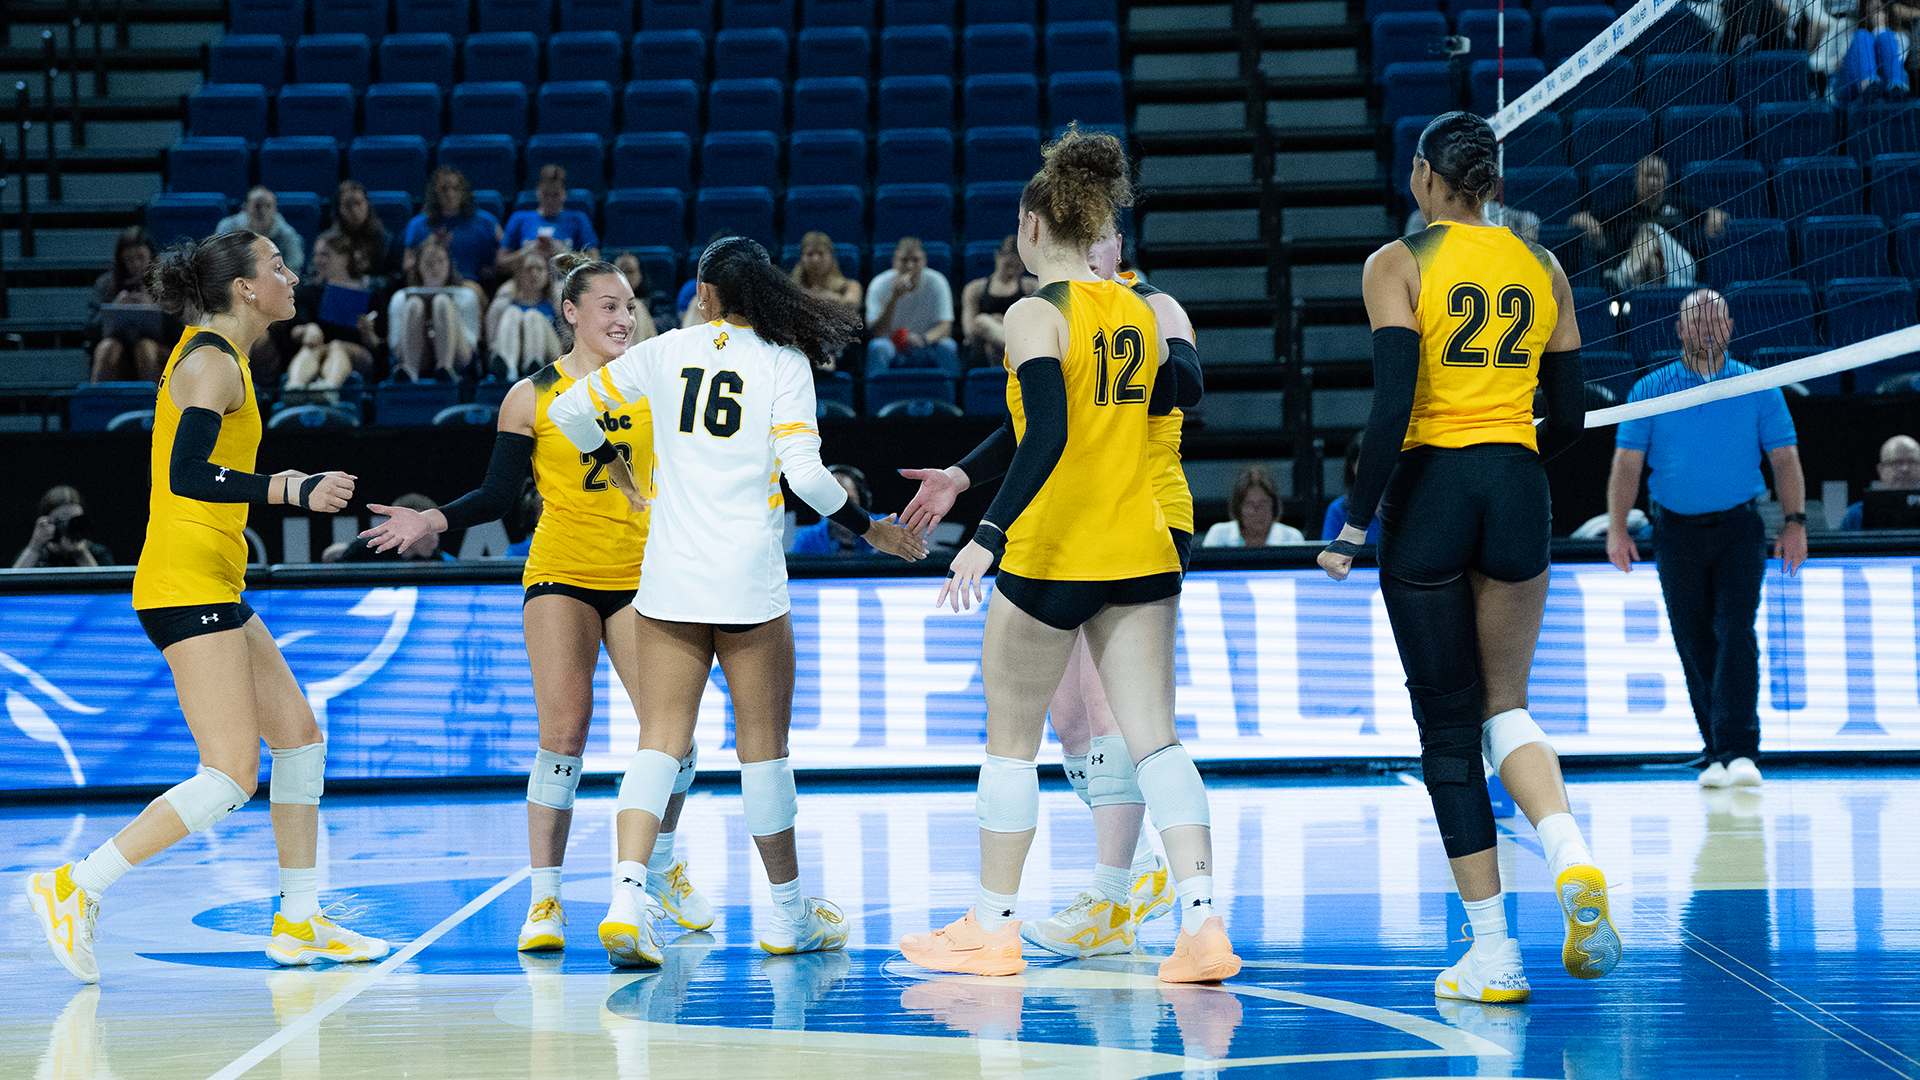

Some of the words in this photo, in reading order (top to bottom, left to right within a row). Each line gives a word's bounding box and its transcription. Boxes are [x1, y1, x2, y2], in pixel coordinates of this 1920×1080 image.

[1441, 282, 1535, 369] 22
[678, 366, 745, 439] 16
[1093, 325, 1147, 406] 12
[1195, 861, 1206, 870] 12
